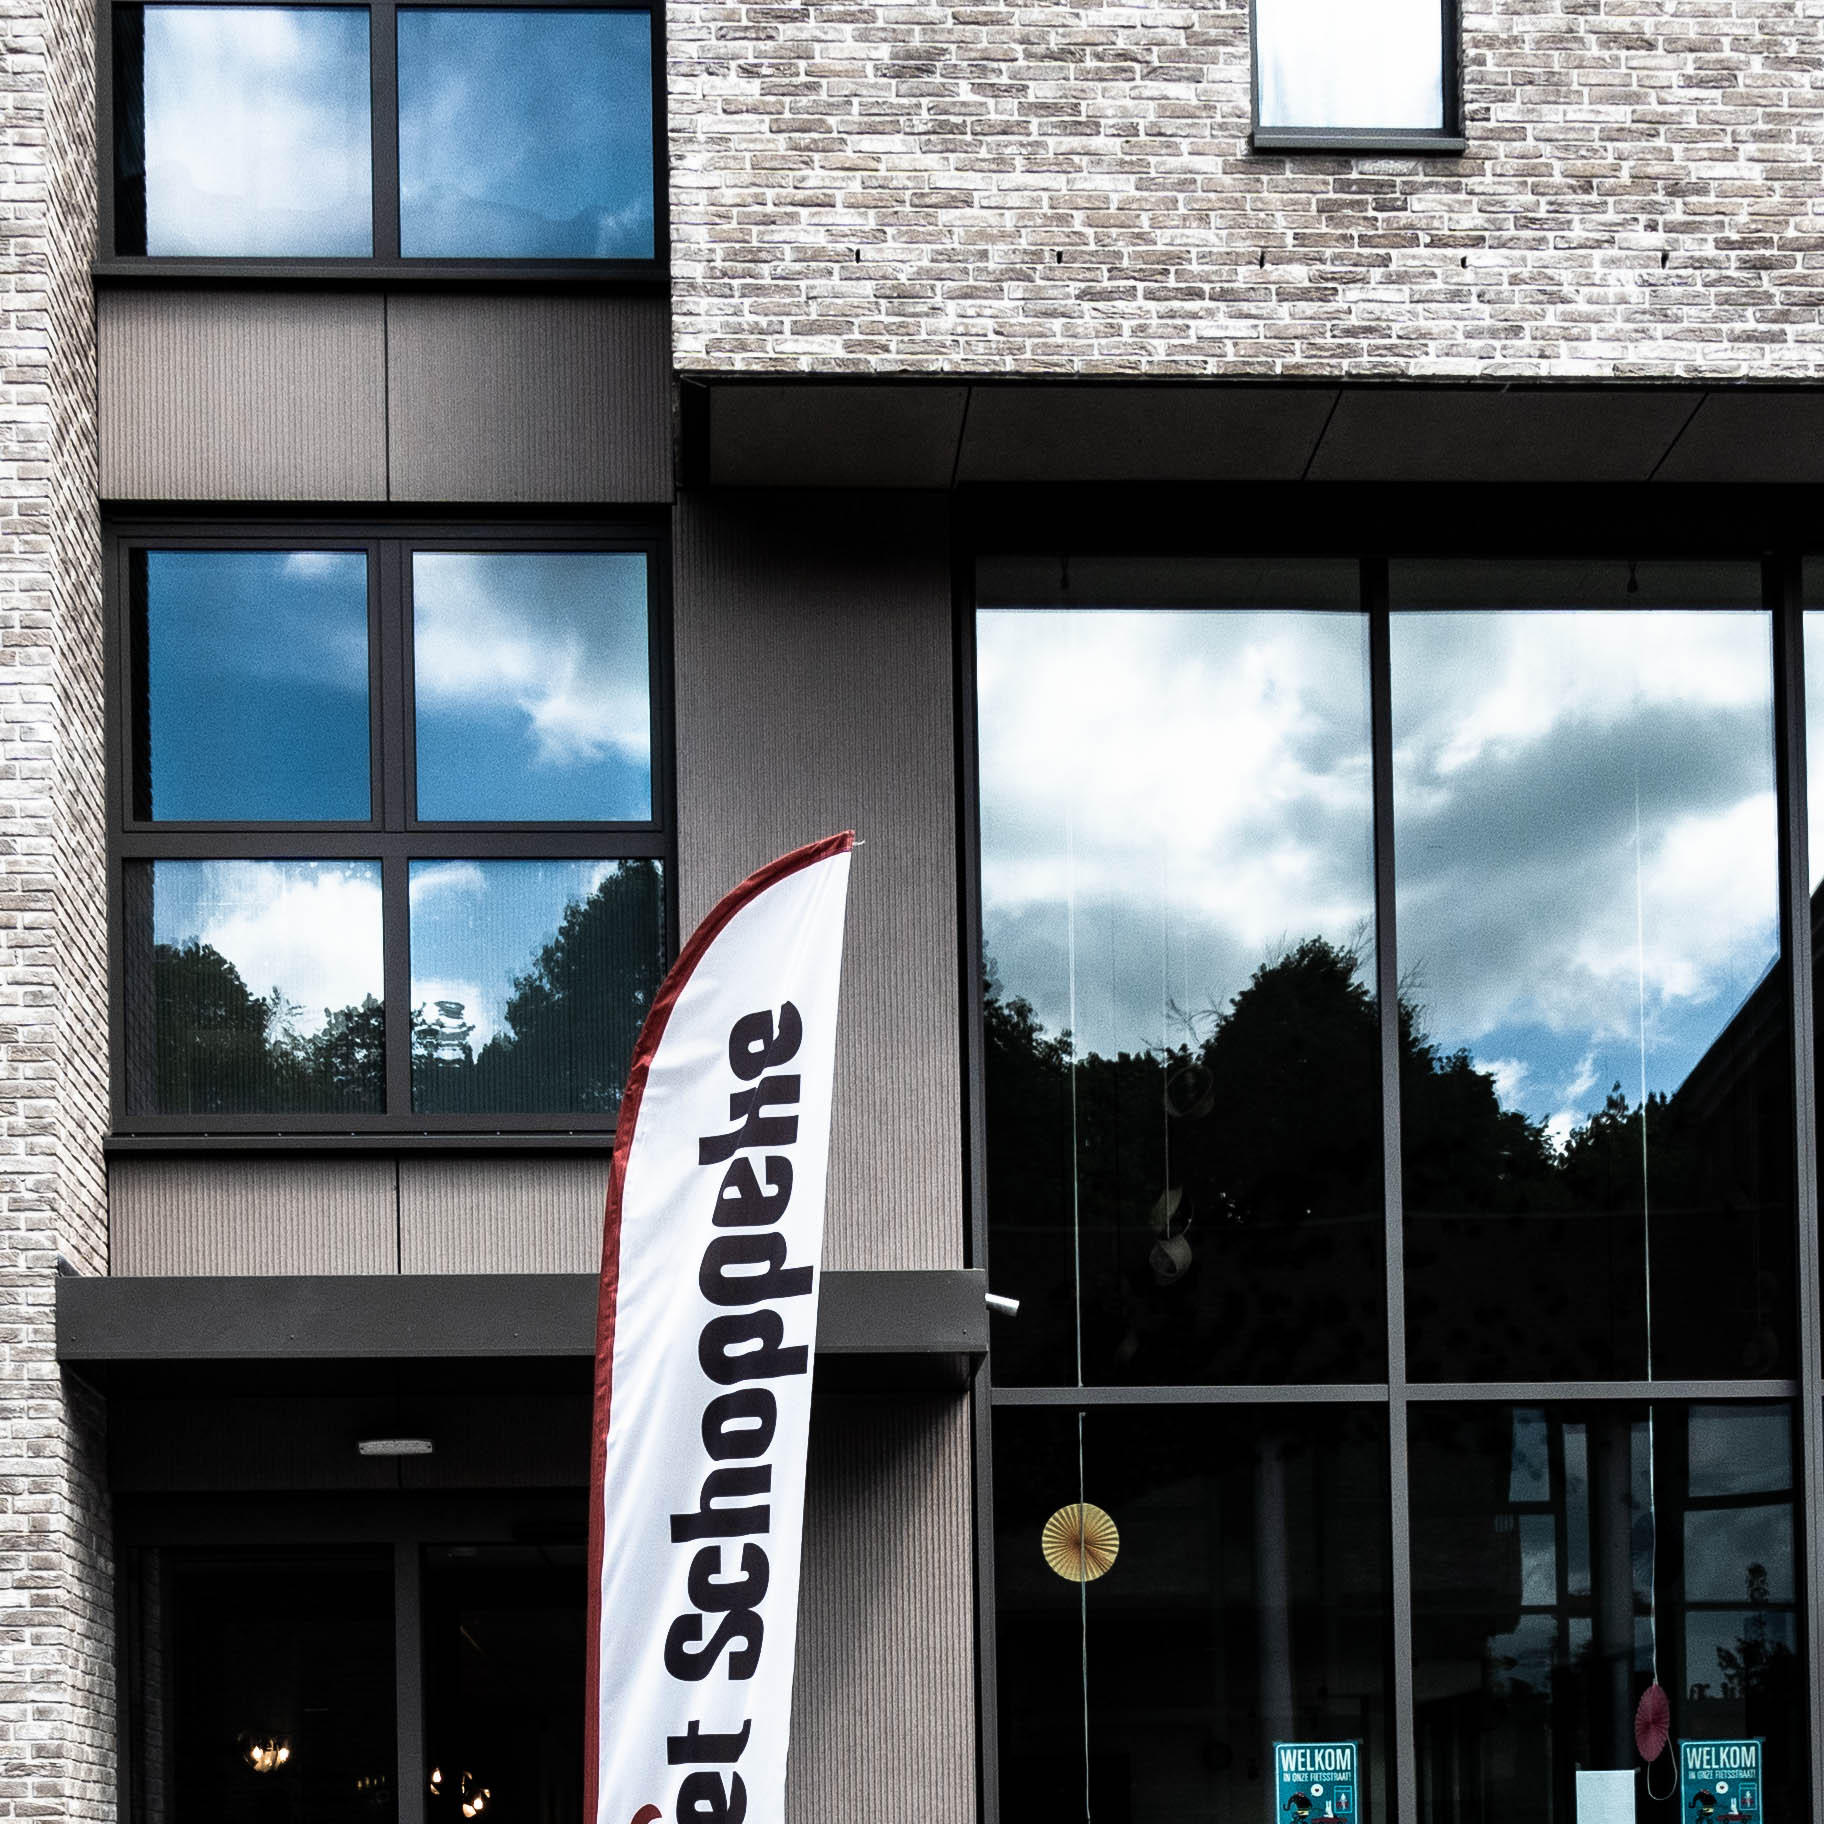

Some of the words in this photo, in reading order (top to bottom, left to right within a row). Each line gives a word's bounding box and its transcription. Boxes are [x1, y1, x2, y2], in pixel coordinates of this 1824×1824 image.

[662, 1000, 814, 1682] Schoppeke
[1280, 1748, 1351, 1772] WELKOM
[1686, 1746, 1756, 1769] WELKOM
